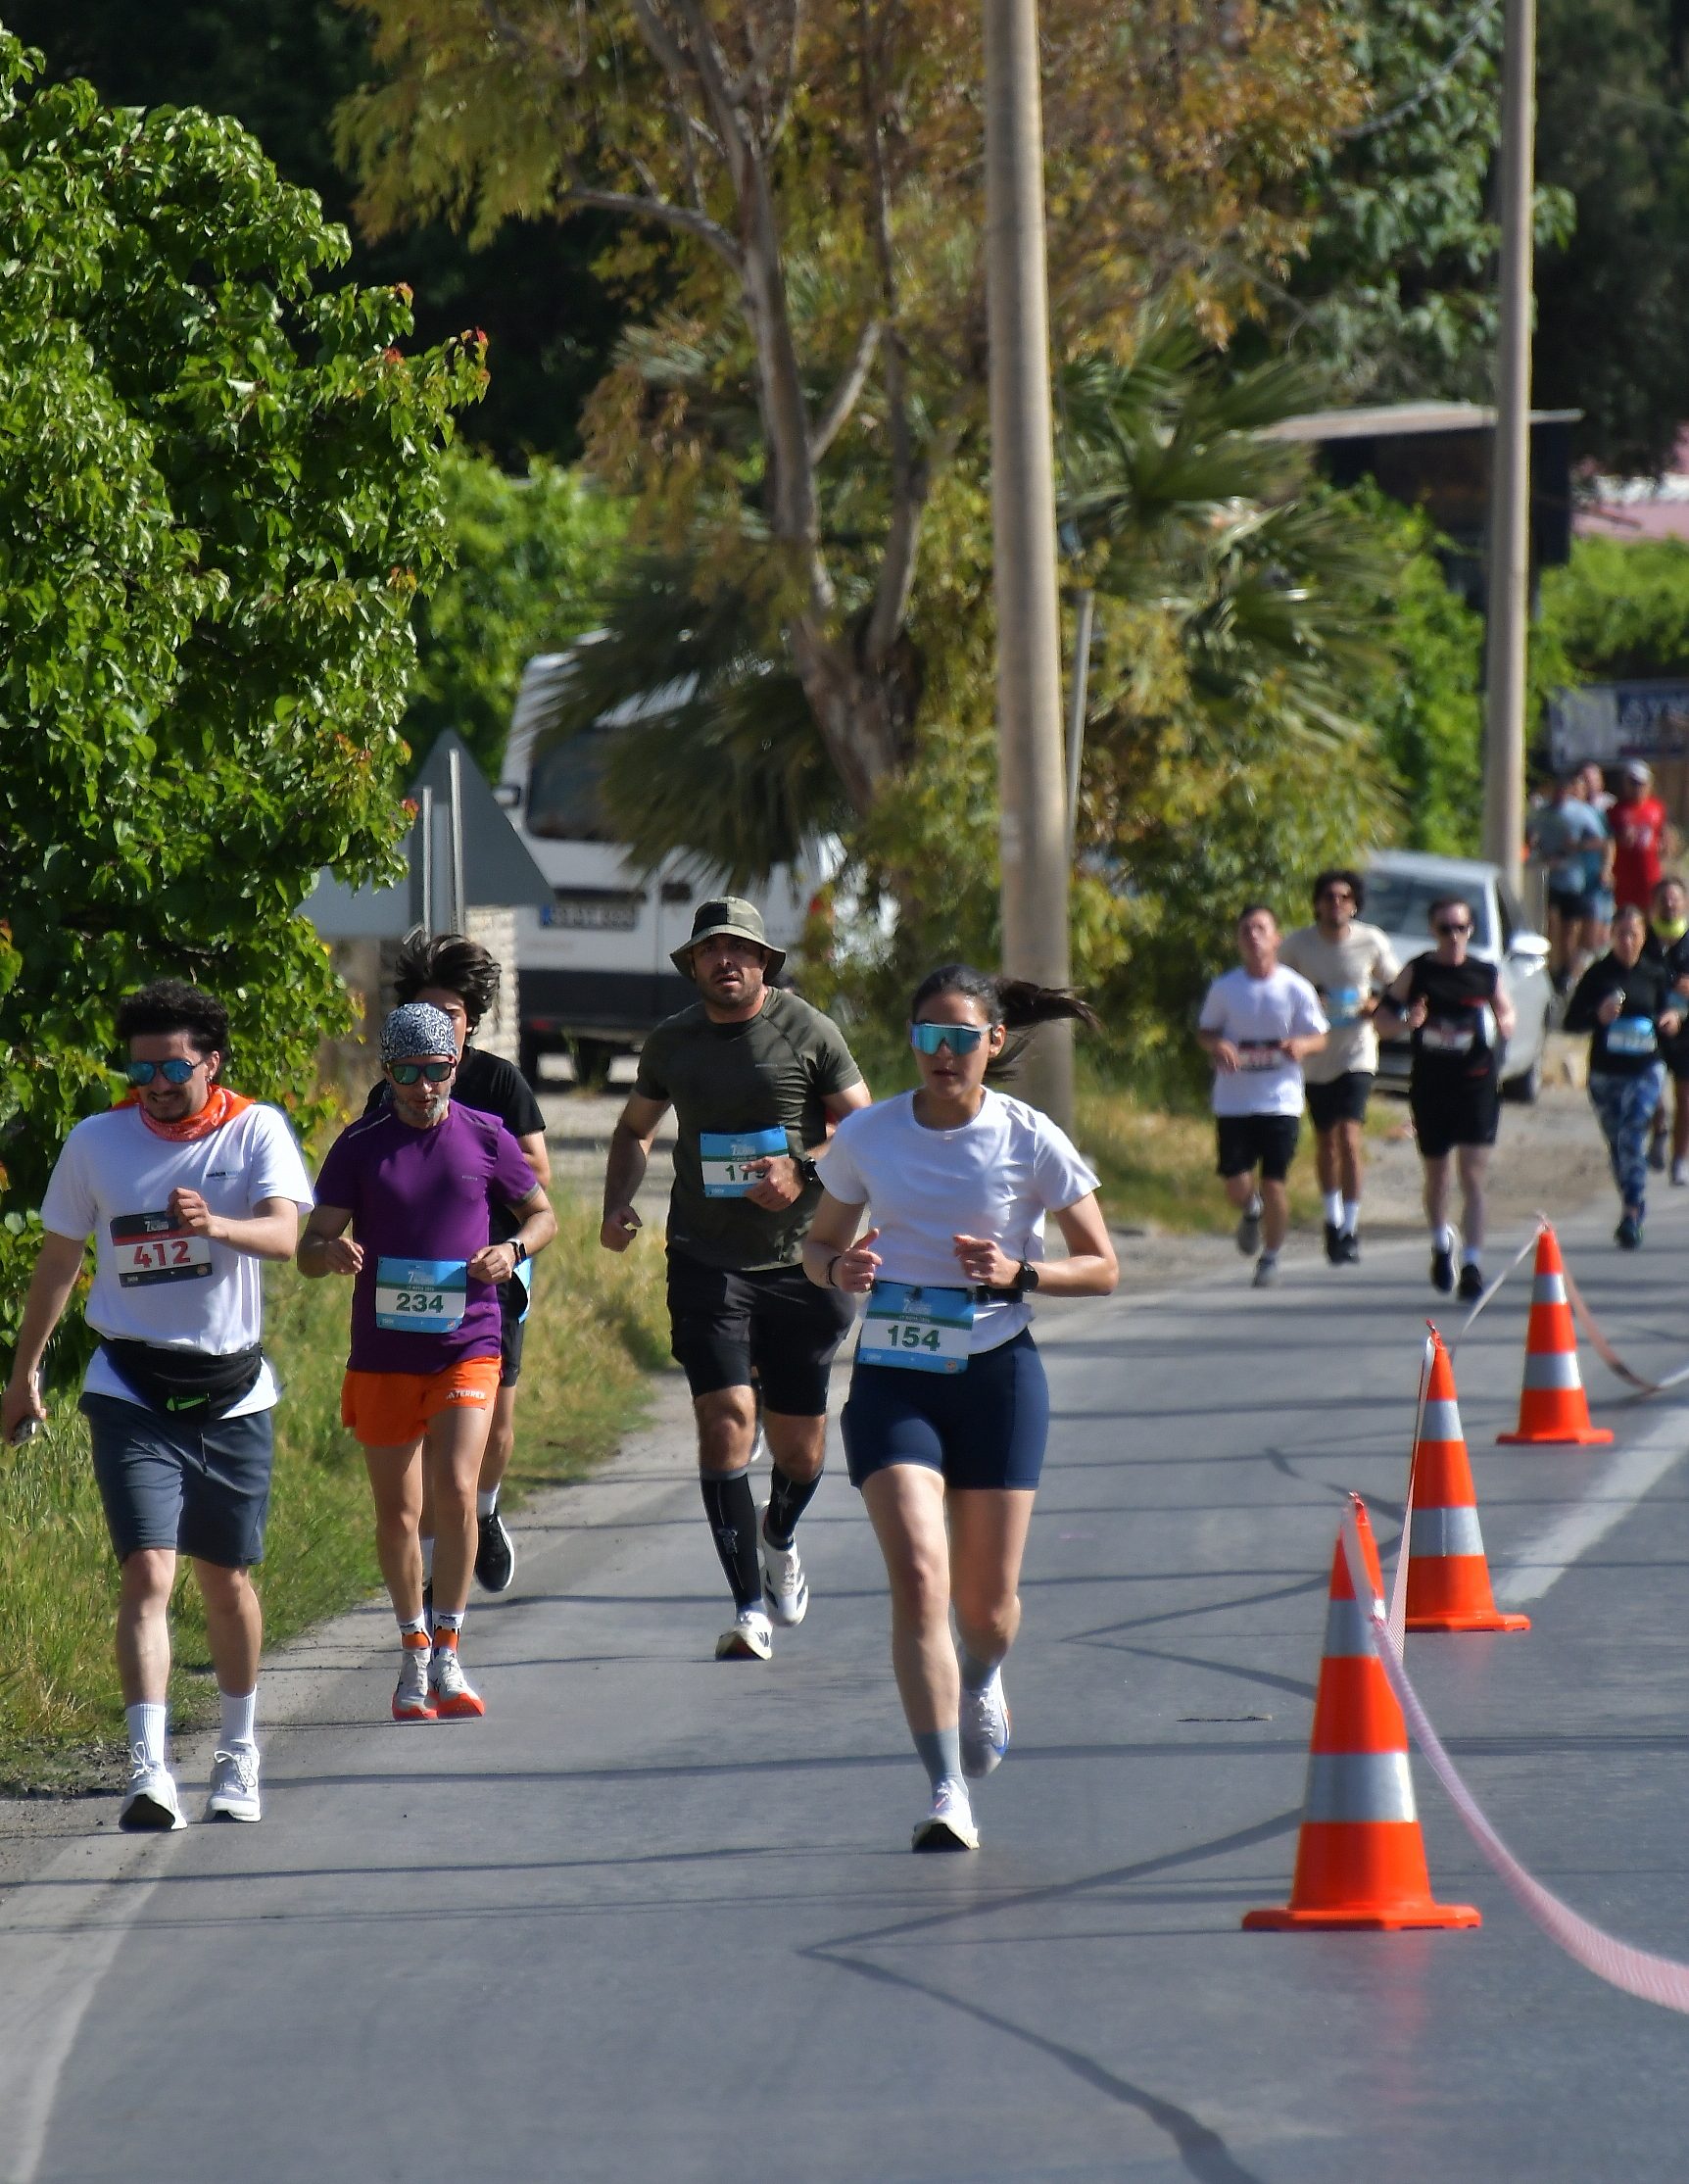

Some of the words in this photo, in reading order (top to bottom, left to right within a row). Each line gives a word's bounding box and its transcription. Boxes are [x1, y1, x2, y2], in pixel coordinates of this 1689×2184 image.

[133, 1240, 191, 1269] 412
[396, 1292, 444, 1314] 234
[888, 1325, 941, 1352] 154
